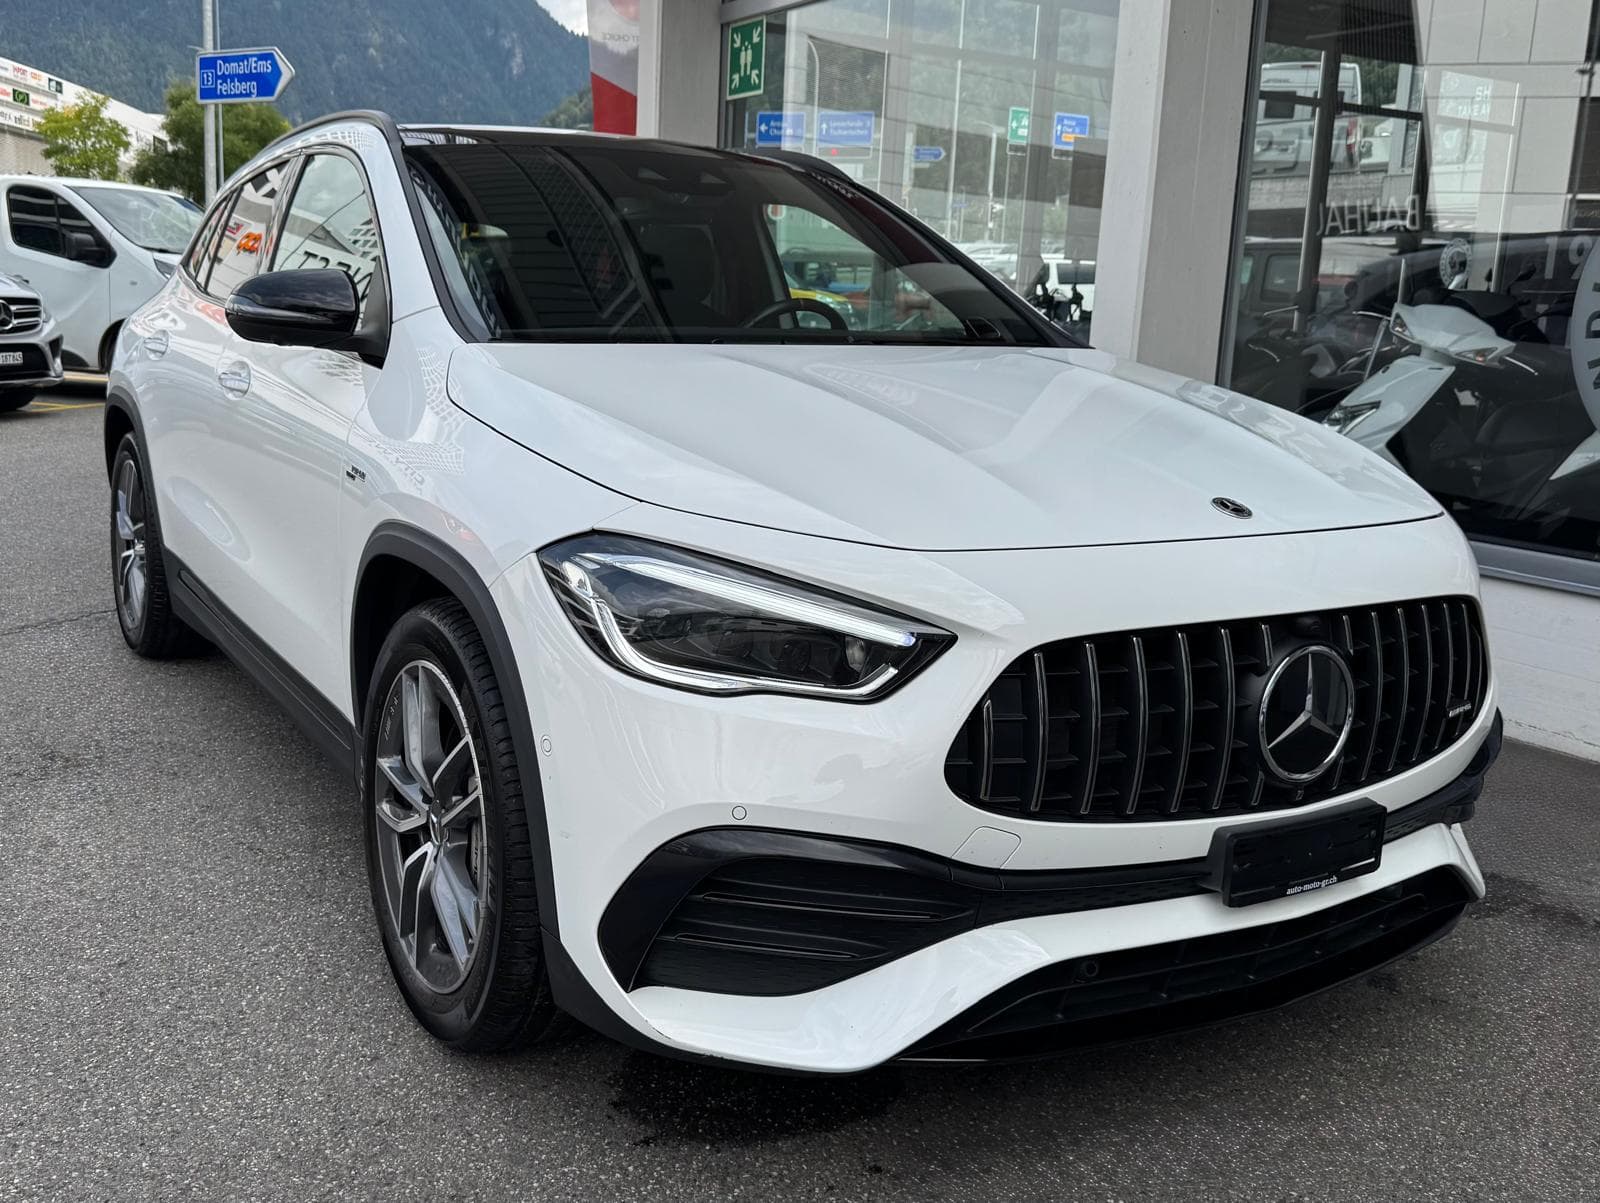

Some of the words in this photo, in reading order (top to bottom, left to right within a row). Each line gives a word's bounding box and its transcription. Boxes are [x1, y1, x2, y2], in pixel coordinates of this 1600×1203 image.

[217, 57, 272, 75] Domat/Ems
[203, 72, 213, 85] 13
[217, 78, 257, 98] Felsberg
[1286, 875, 1338, 895] auto-moto-gr.ch
